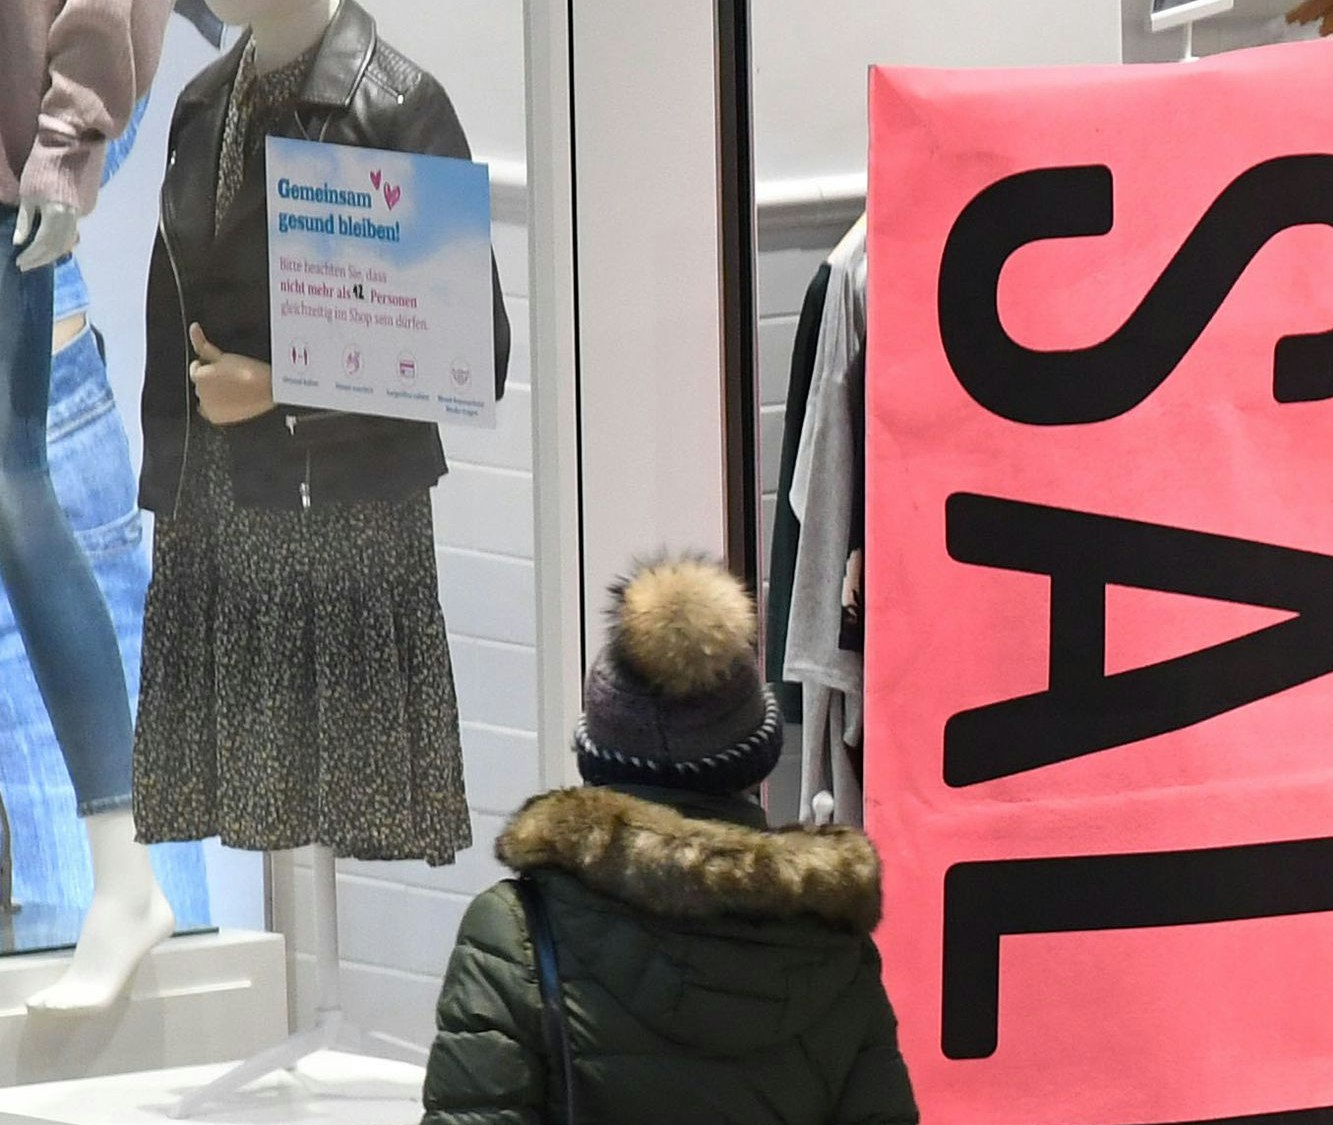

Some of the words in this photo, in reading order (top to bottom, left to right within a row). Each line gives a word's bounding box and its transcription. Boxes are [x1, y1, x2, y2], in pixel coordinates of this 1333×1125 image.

[277, 178, 372, 208] Gemeinsam
[278, 212, 335, 235] gesund
[338, 213, 400, 242] bleiben!
[279, 256, 303, 272] Bitte
[304, 259, 346, 278] beachten
[365, 268, 388, 284] dass
[280, 278, 305, 295] nicht
[307, 281, 334, 299] mehr
[336, 286, 351, 300] als
[370, 289, 418, 308] Personen
[280, 300, 333, 323] gleichzeitig
[334, 306, 348, 321] im
[349, 307, 373, 328] Shop
[374, 313, 394, 327] sein
